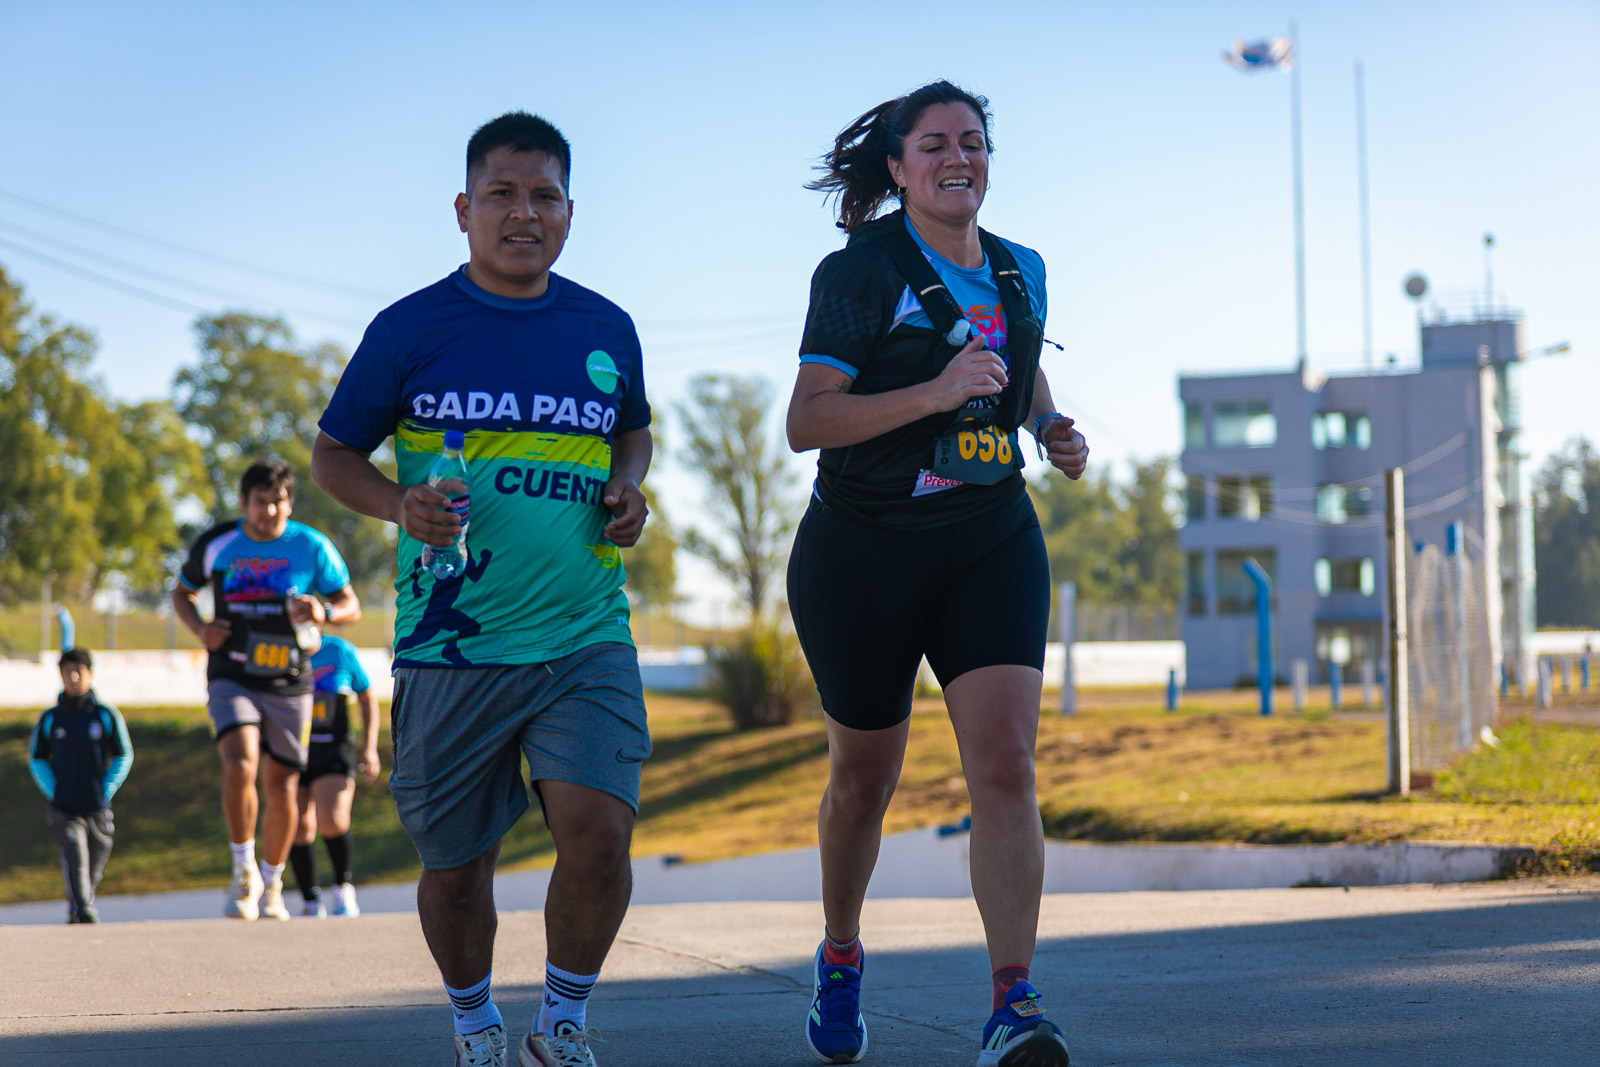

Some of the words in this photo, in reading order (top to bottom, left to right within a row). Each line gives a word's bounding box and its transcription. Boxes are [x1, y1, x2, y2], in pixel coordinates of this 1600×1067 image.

[412, 391, 521, 421] CADA
[531, 394, 615, 434] PASO
[958, 417, 1012, 464] 658
[494, 465, 607, 506] CUENT
